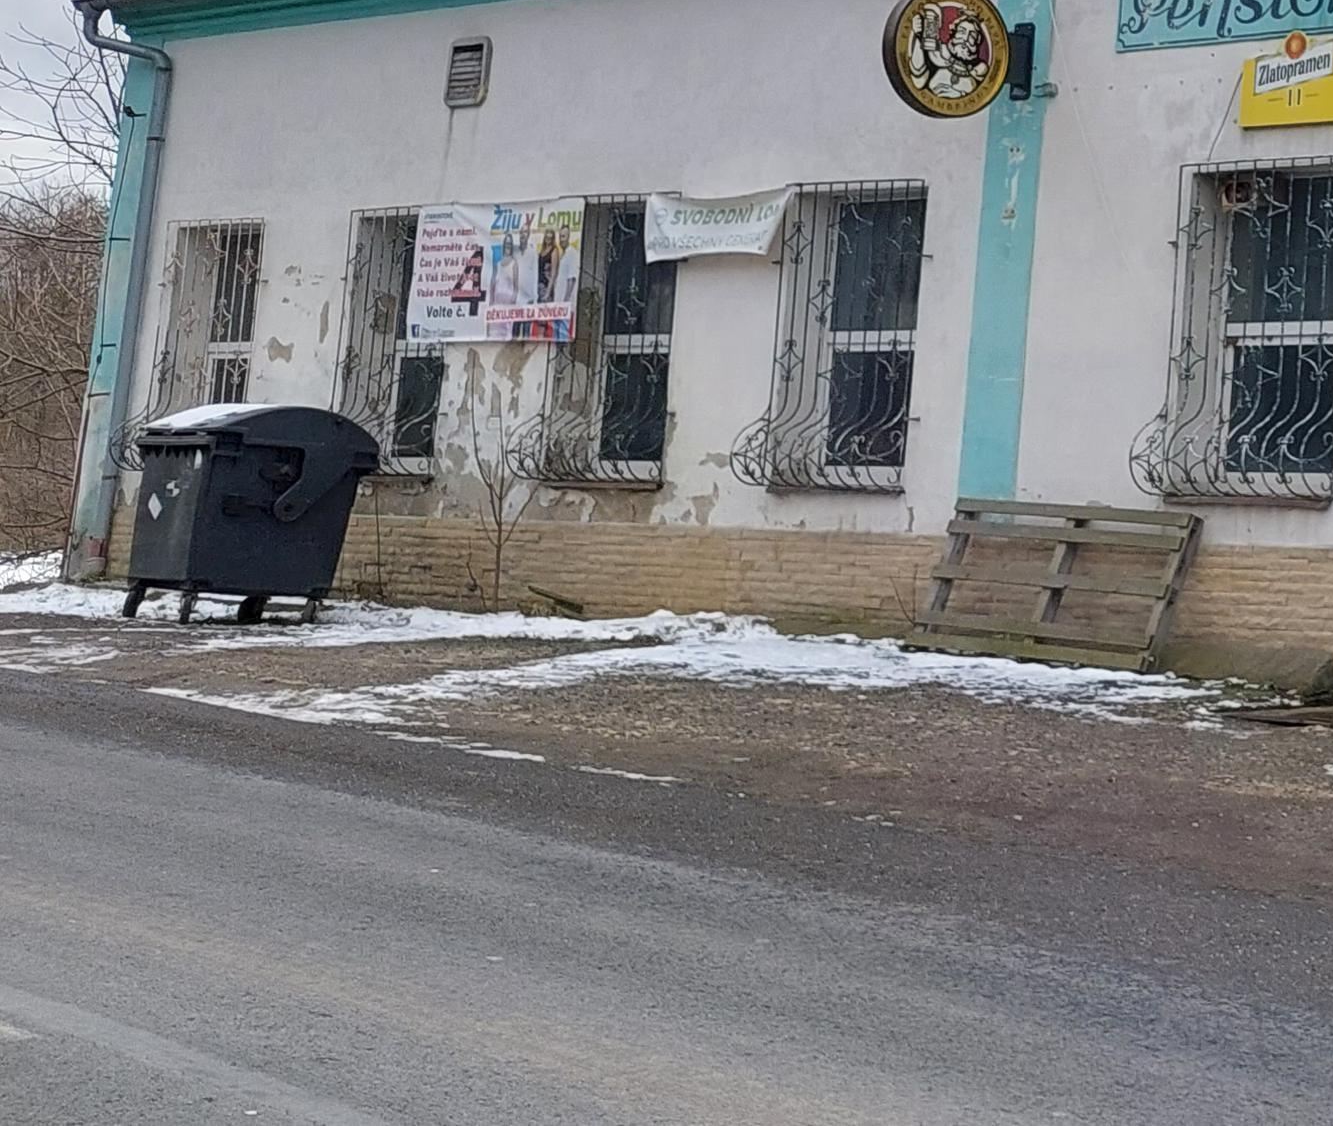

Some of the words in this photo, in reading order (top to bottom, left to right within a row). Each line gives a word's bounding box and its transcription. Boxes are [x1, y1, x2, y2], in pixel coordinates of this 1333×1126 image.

[1257, 53, 1331, 87] Zlatopramen
[490, 203, 521, 233] Žiju
[538, 207, 582, 228] Lomu
[670, 202, 755, 226] SVOBODNÍ
[420, 257, 432, 268] Čas
[434, 258, 442, 271] je
[418, 274, 423, 282] A
[451, 246, 487, 317] 4
[426, 305, 453, 318] Volte
[456, 305, 466, 317] č.
